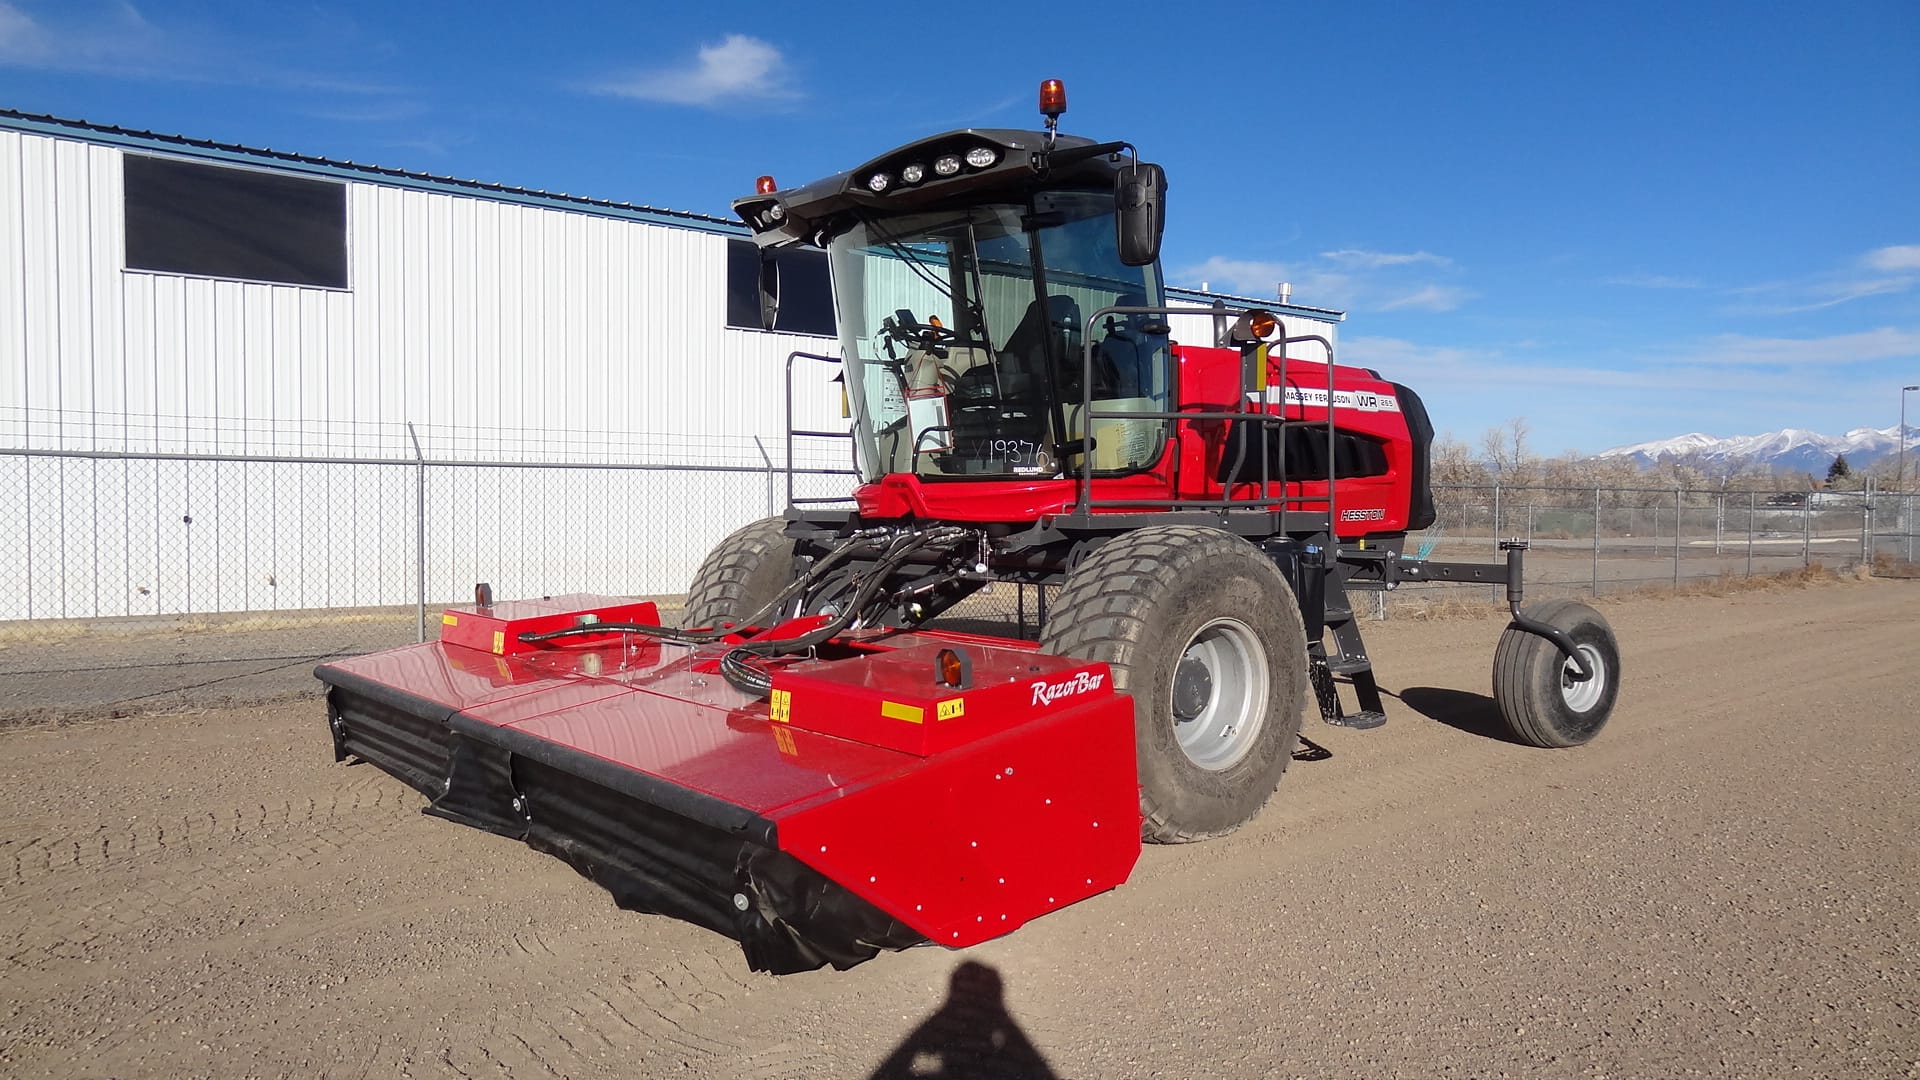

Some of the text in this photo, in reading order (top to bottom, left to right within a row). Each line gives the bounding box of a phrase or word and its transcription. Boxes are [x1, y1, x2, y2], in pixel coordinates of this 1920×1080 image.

[1284, 391, 1313, 401] MASSEY
[1314, 393, 1351, 404] FERUSON
[1356, 395, 1378, 408] WR
[989, 439, 1050, 468] 19376
[1340, 508, 1386, 522] HESSTON
